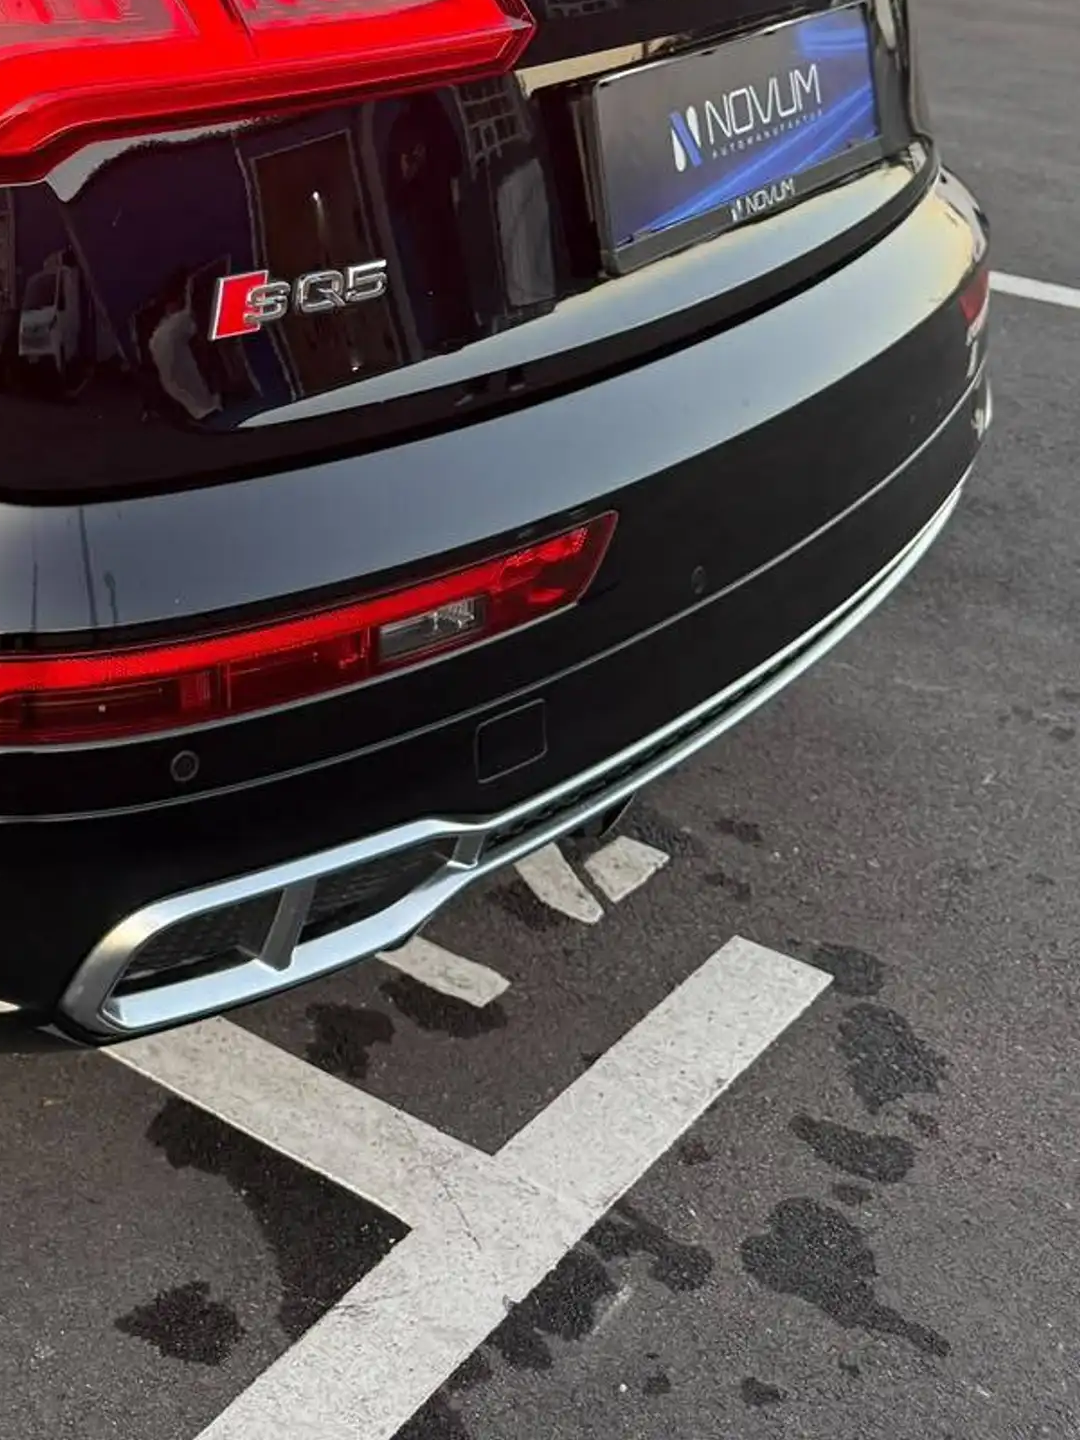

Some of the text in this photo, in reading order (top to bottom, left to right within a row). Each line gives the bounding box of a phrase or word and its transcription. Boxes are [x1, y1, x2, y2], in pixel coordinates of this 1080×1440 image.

[704, 63, 822, 145] NOVUM
[745, 177, 796, 216] NOVUM
[240, 259, 388, 325] SQ5
